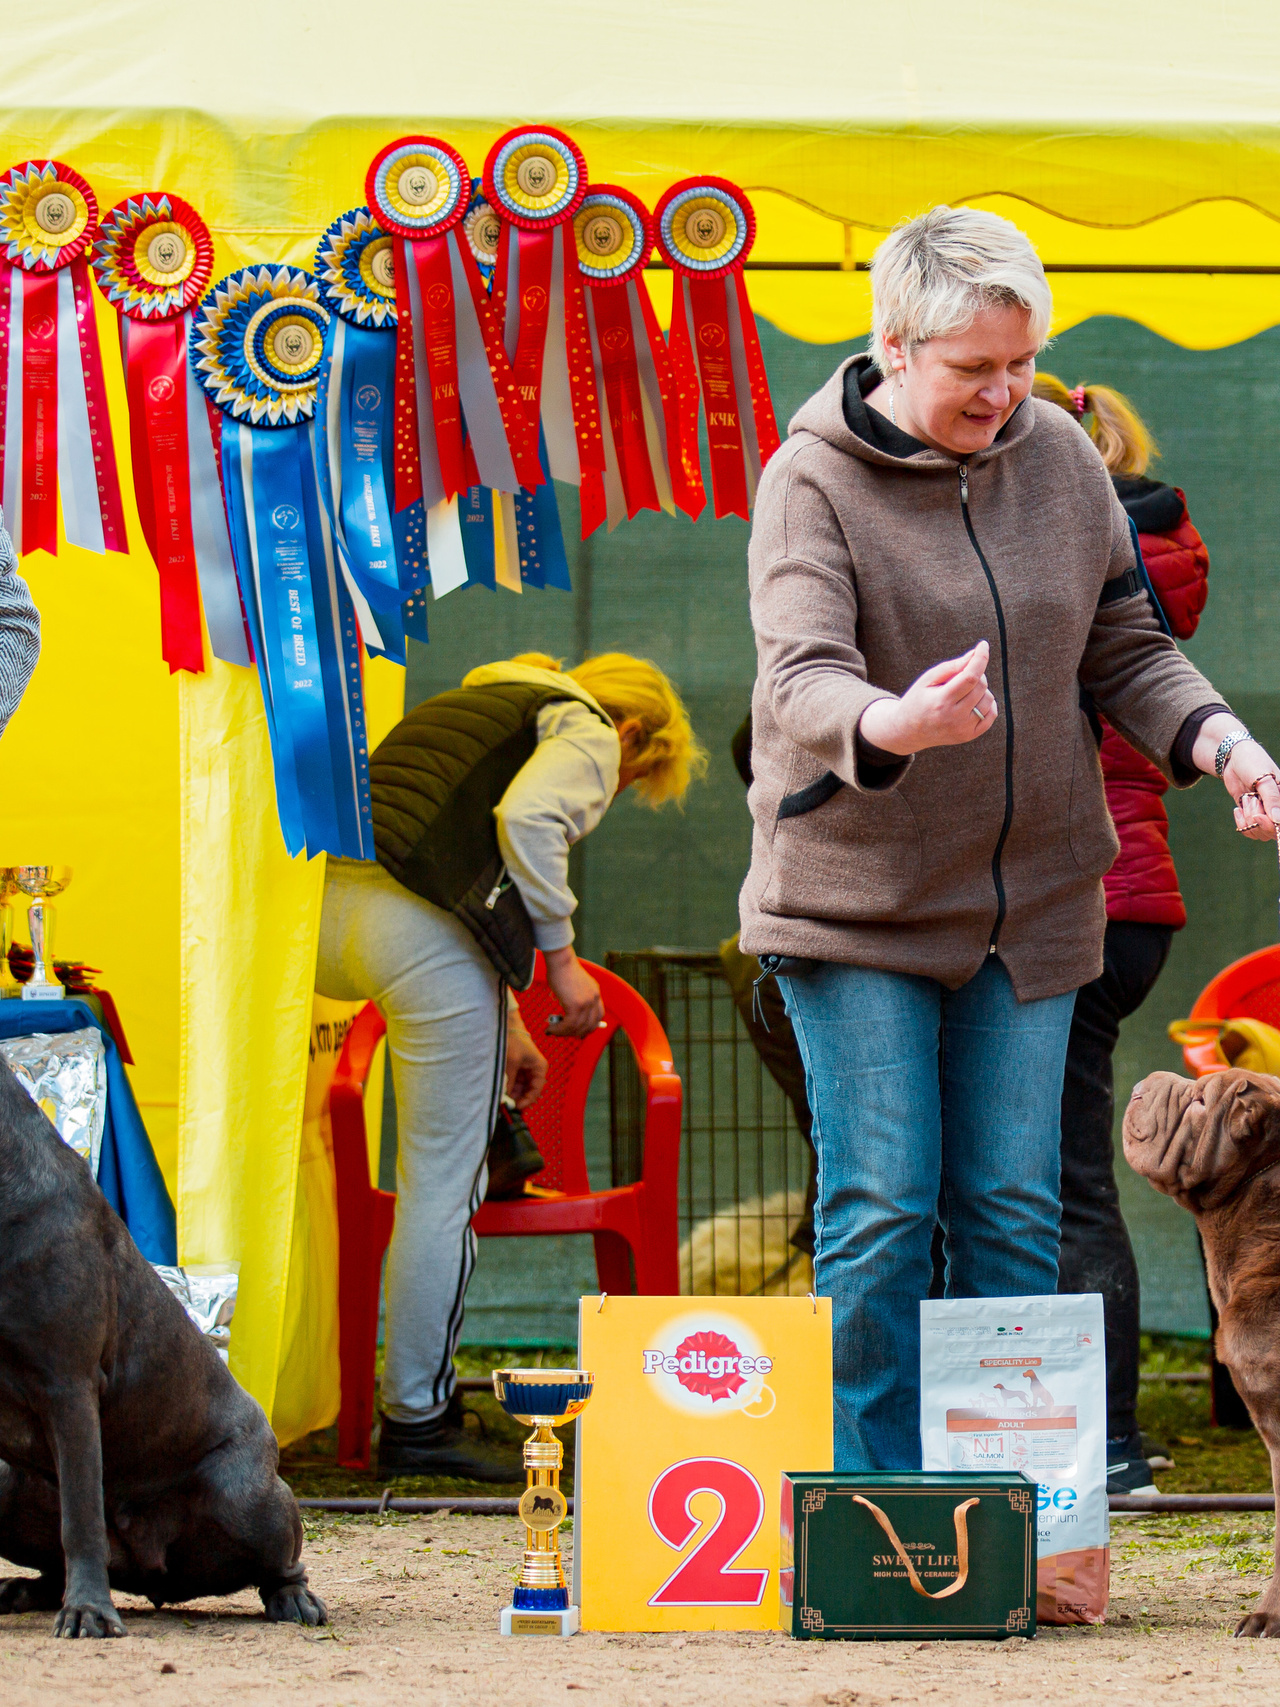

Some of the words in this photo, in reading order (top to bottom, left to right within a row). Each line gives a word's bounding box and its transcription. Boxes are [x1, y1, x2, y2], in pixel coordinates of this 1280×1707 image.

[434, 383, 455, 400] КЧК
[709, 412, 736, 427] КЧК
[30, 493, 48, 501] 2022
[466, 514, 484, 522] 2022
[168, 555, 186, 564] 2022
[369, 560, 387, 569] 2022
[288, 589, 301, 614] BEST
[291, 616, 302, 630] OF
[293, 634, 306, 666] BREED
[294, 679, 312, 689] 2022
[643, 1350, 773, 1379] Pedigree
[648, 1456, 770, 1606] 2
[928, 1555, 960, 1566] LIFE
